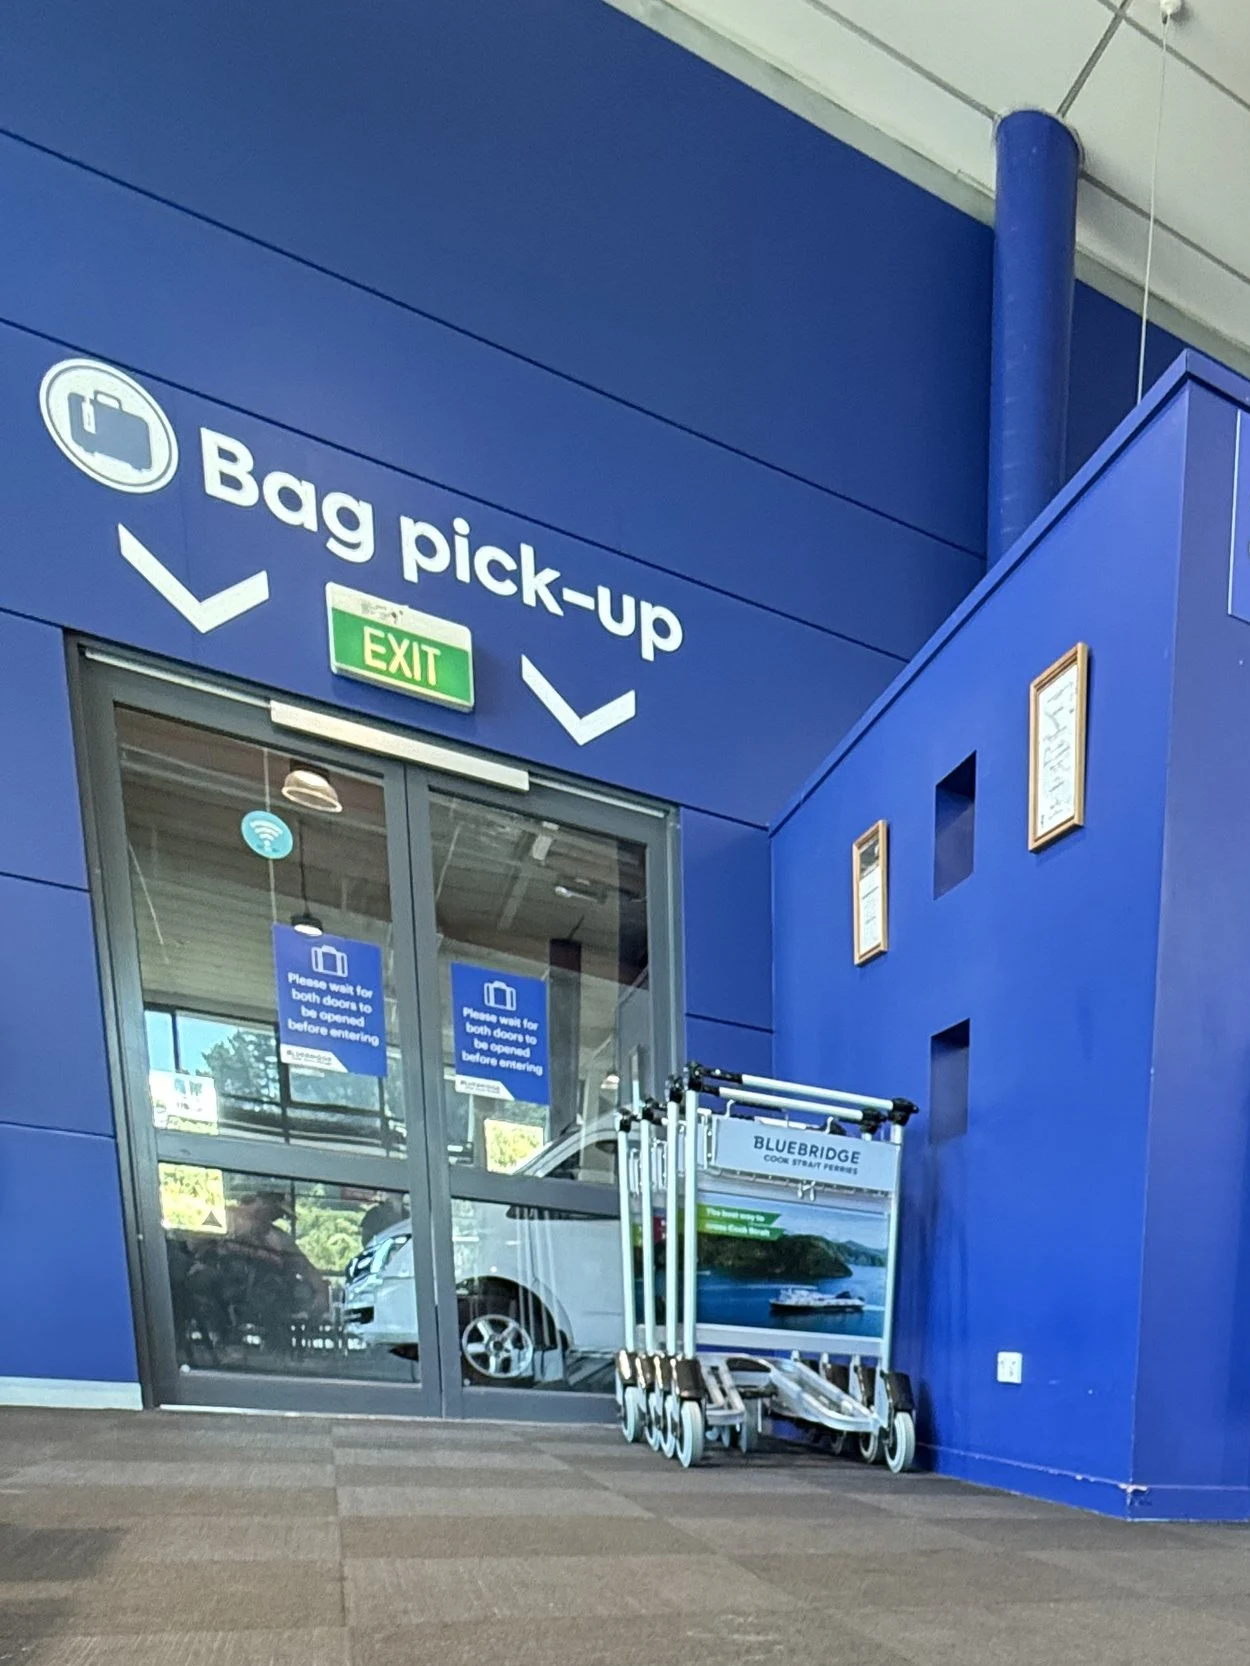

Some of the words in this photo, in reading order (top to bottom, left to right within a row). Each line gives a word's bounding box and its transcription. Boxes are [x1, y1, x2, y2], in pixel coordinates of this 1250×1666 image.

[200, 427, 374, 562] Bag
[400, 514, 683, 660] pick-up
[363, 625, 441, 686] EXIT
[288, 972, 327, 990] Please
[329, 983, 354, 996] wait
[356, 985, 373, 999] for
[291, 988, 320, 1004] both
[322, 995, 357, 1011] doors
[359, 1002, 373, 1014] to
[301, 1005, 317, 1018] be
[319, 1011, 365, 1027] opened
[463, 1007, 497, 1023] Please
[499, 1016, 521, 1028] wait
[523, 1018, 539, 1031] for
[288, 1018, 328, 1036] before
[329, 1028, 379, 1047] entering
[465, 1021, 491, 1036] both
[493, 1028, 524, 1043] doors
[525, 1034, 537, 1045] to
[474, 1038, 488, 1050] be
[490, 1043, 531, 1058] opened
[462, 1050, 497, 1066] before
[499, 1059, 543, 1076] entering
[754, 1135, 861, 1165] BLUEBRIDGE
[763, 1153, 789, 1165] COOK
[791, 1158, 821, 1170] STRAIT
[823, 1162, 858, 1175] FERRIES
